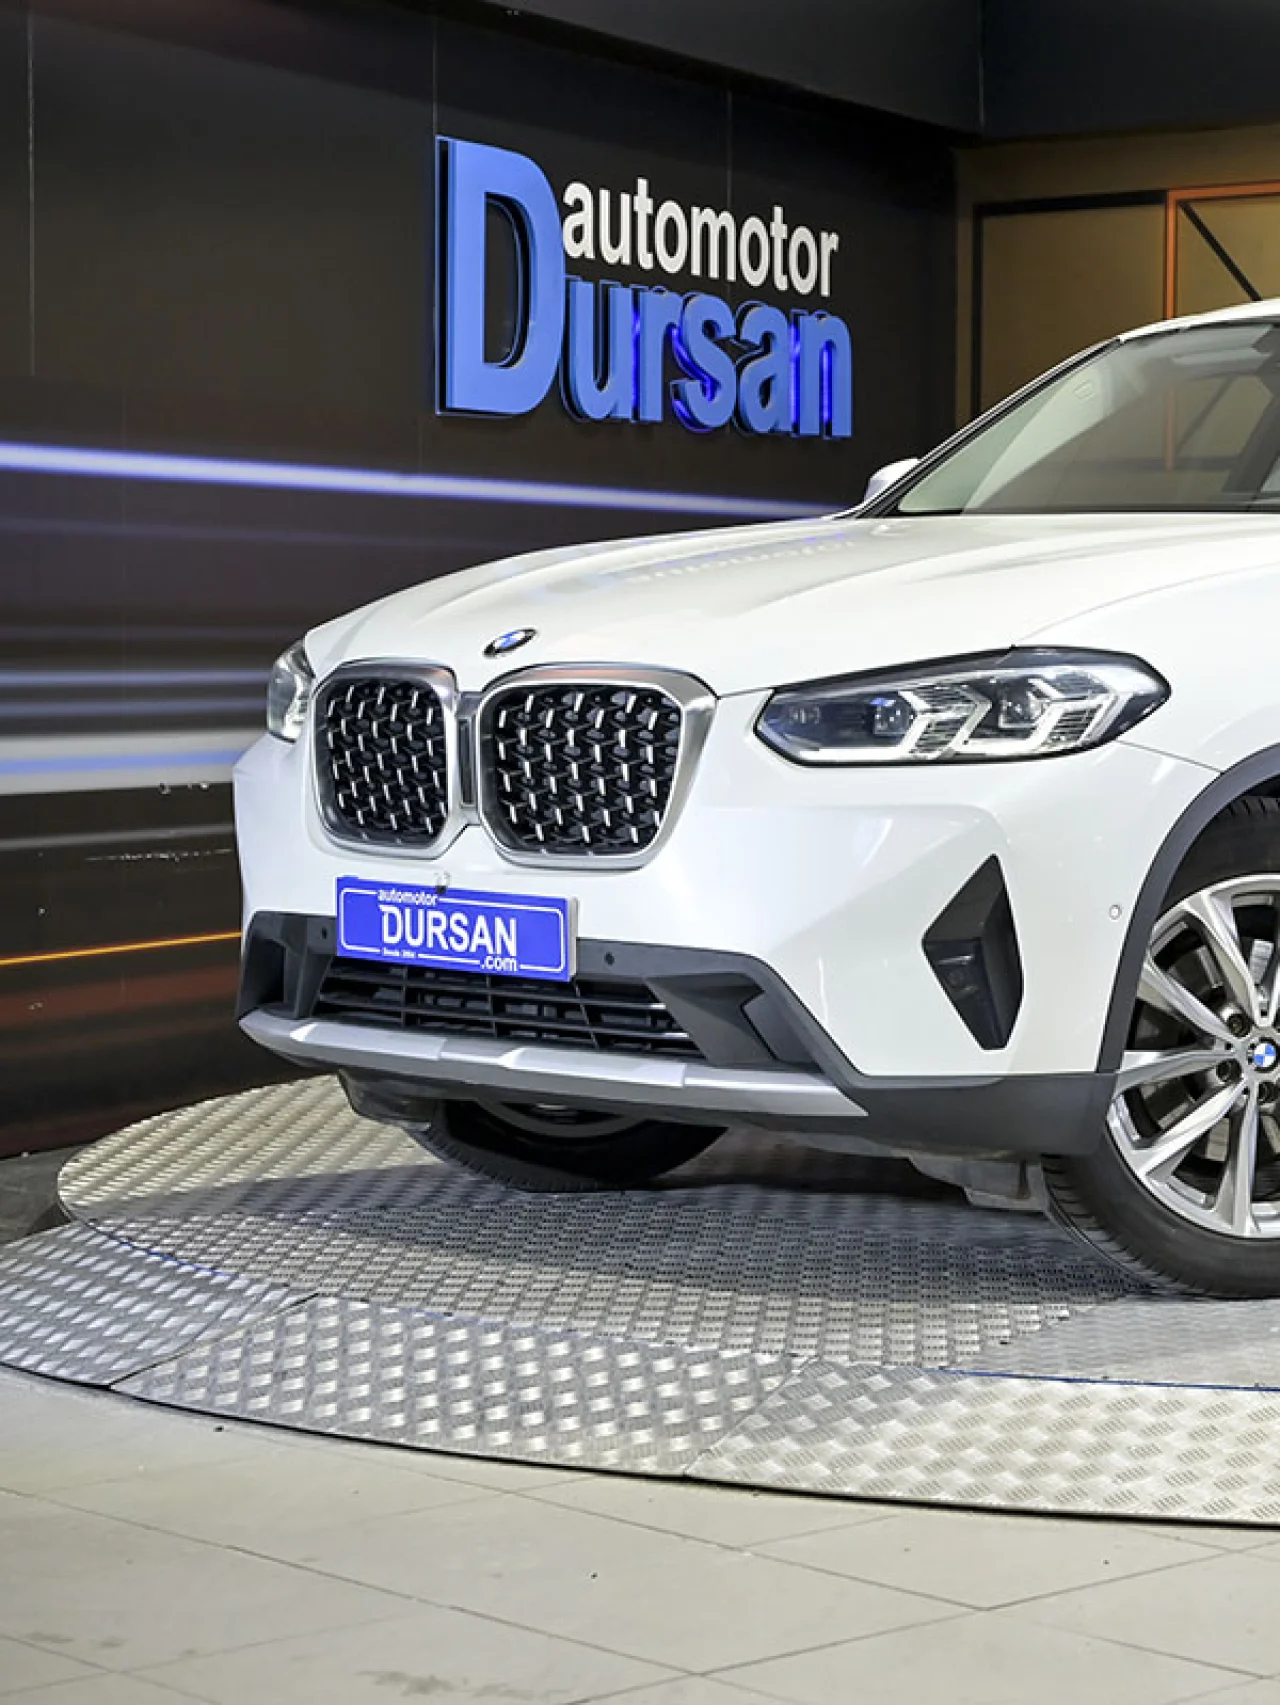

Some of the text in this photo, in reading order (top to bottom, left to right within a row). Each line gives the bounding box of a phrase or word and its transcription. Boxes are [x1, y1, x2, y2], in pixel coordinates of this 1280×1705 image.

[562, 176, 840, 297] automotor
[435, 134, 853, 439] Dursan
[377, 888, 439, 907] automotor
[379, 904, 517, 956] DURSAN
[480, 956, 519, 972] .com
